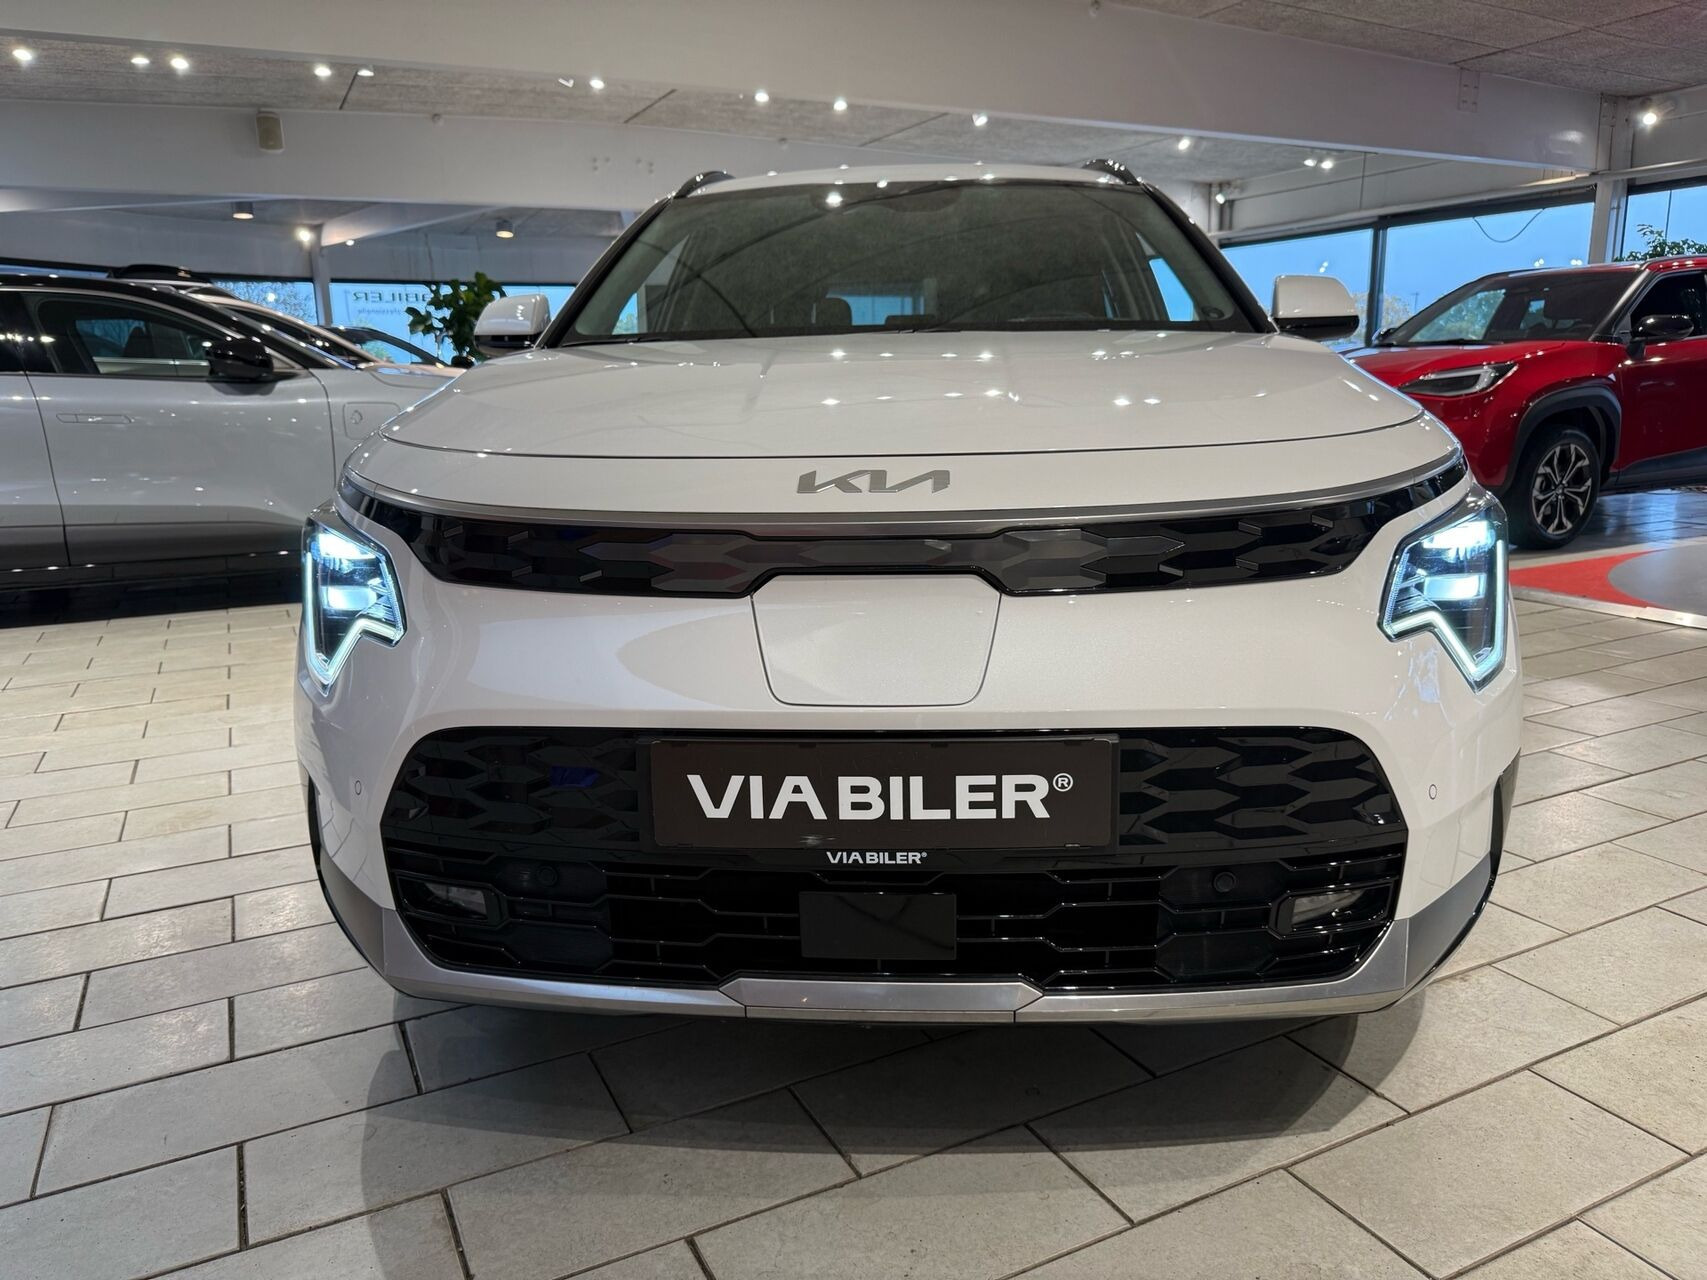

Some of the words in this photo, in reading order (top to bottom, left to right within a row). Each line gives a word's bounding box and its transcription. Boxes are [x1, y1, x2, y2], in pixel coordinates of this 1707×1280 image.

[797, 469, 950, 494] KIA
[686, 774, 828, 820] VIA
[826, 851, 864, 864] VIA
